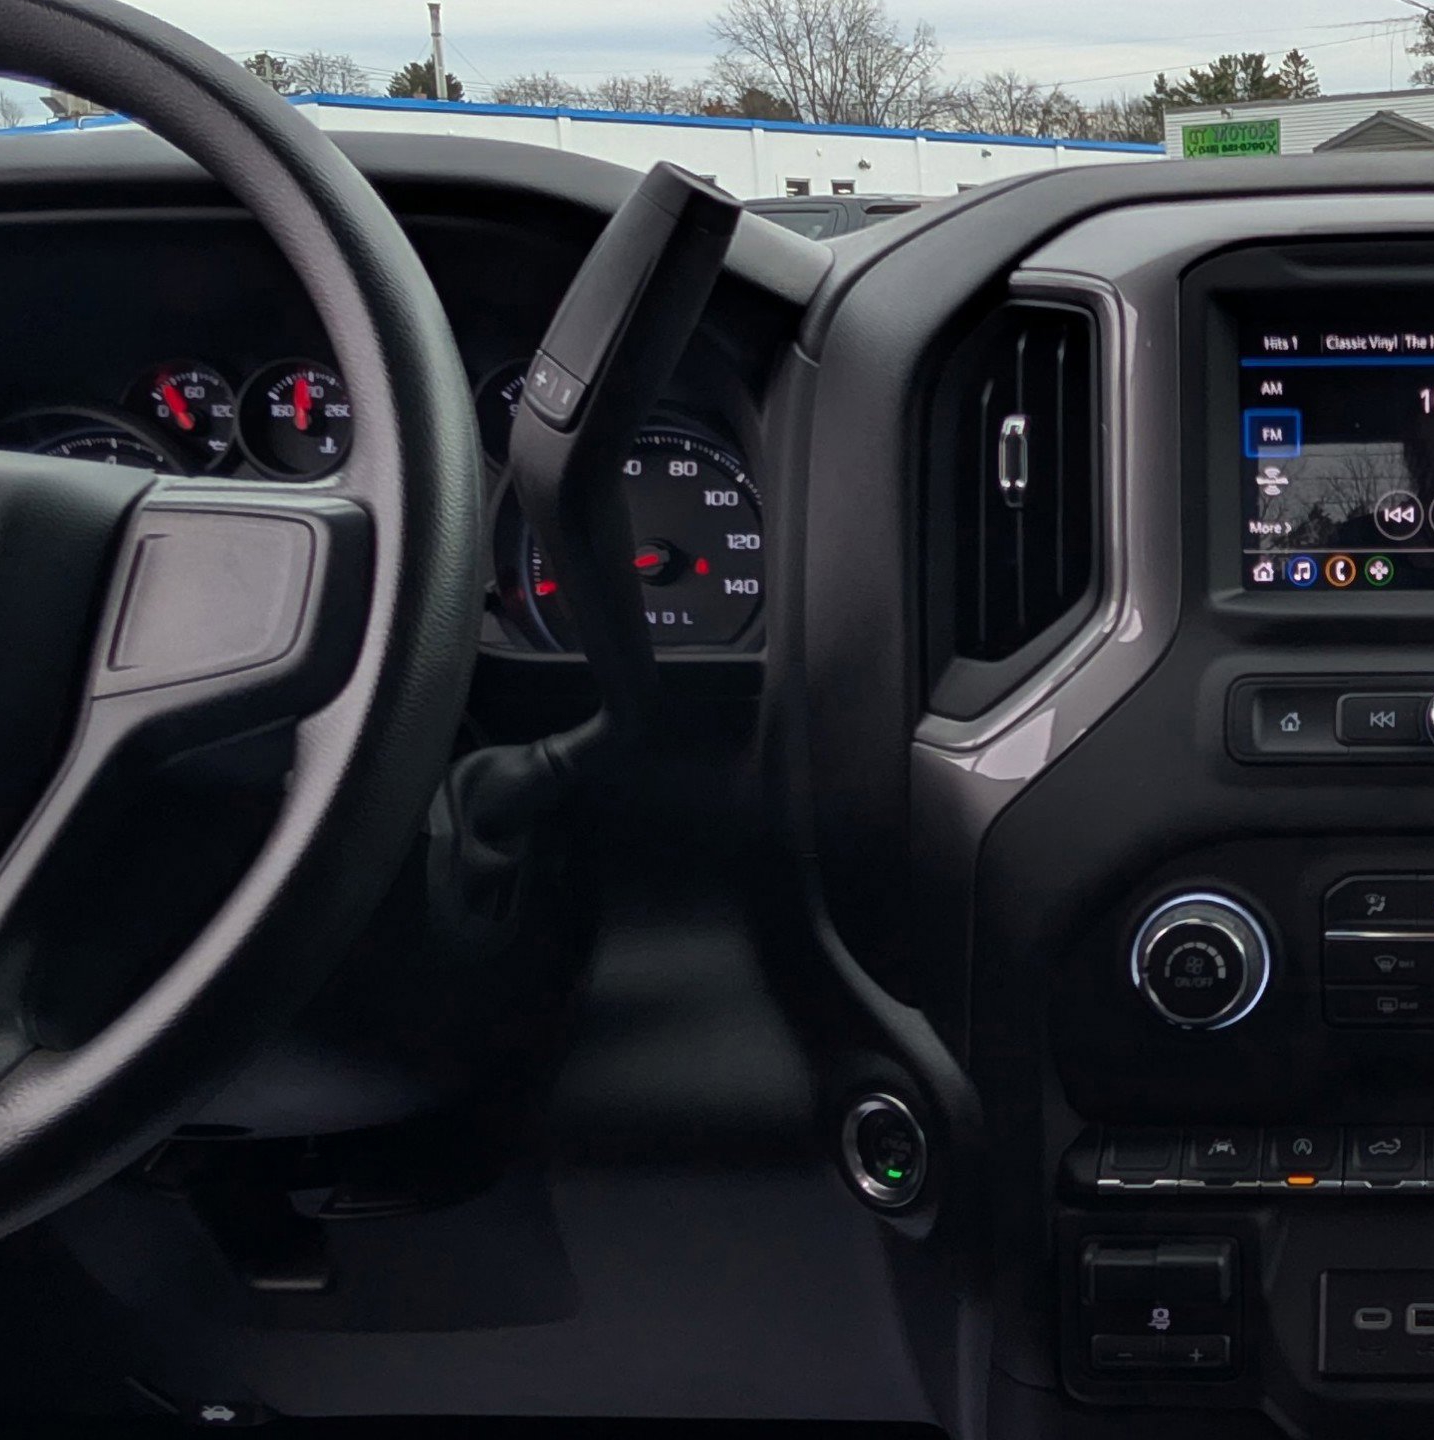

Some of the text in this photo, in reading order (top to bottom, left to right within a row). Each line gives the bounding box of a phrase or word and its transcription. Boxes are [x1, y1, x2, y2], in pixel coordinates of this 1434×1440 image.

[1264, 335, 1290, 351] Hits
[1326, 334, 1367, 351] Classic
[1368, 334, 1398, 352] Vinyl
[1405, 334, 1427, 350] The
[1260, 381, 1283, 396] AM
[1261, 427, 1283, 443] FM
[669, 461, 698, 477] 80
[704, 490, 739, 507] 100
[1249, 521, 1283, 535] More
[726, 534, 760, 550] 120
[724, 578, 759, 595] 140
[662, 612, 675, 625] D
[682, 612, 694, 625] L
